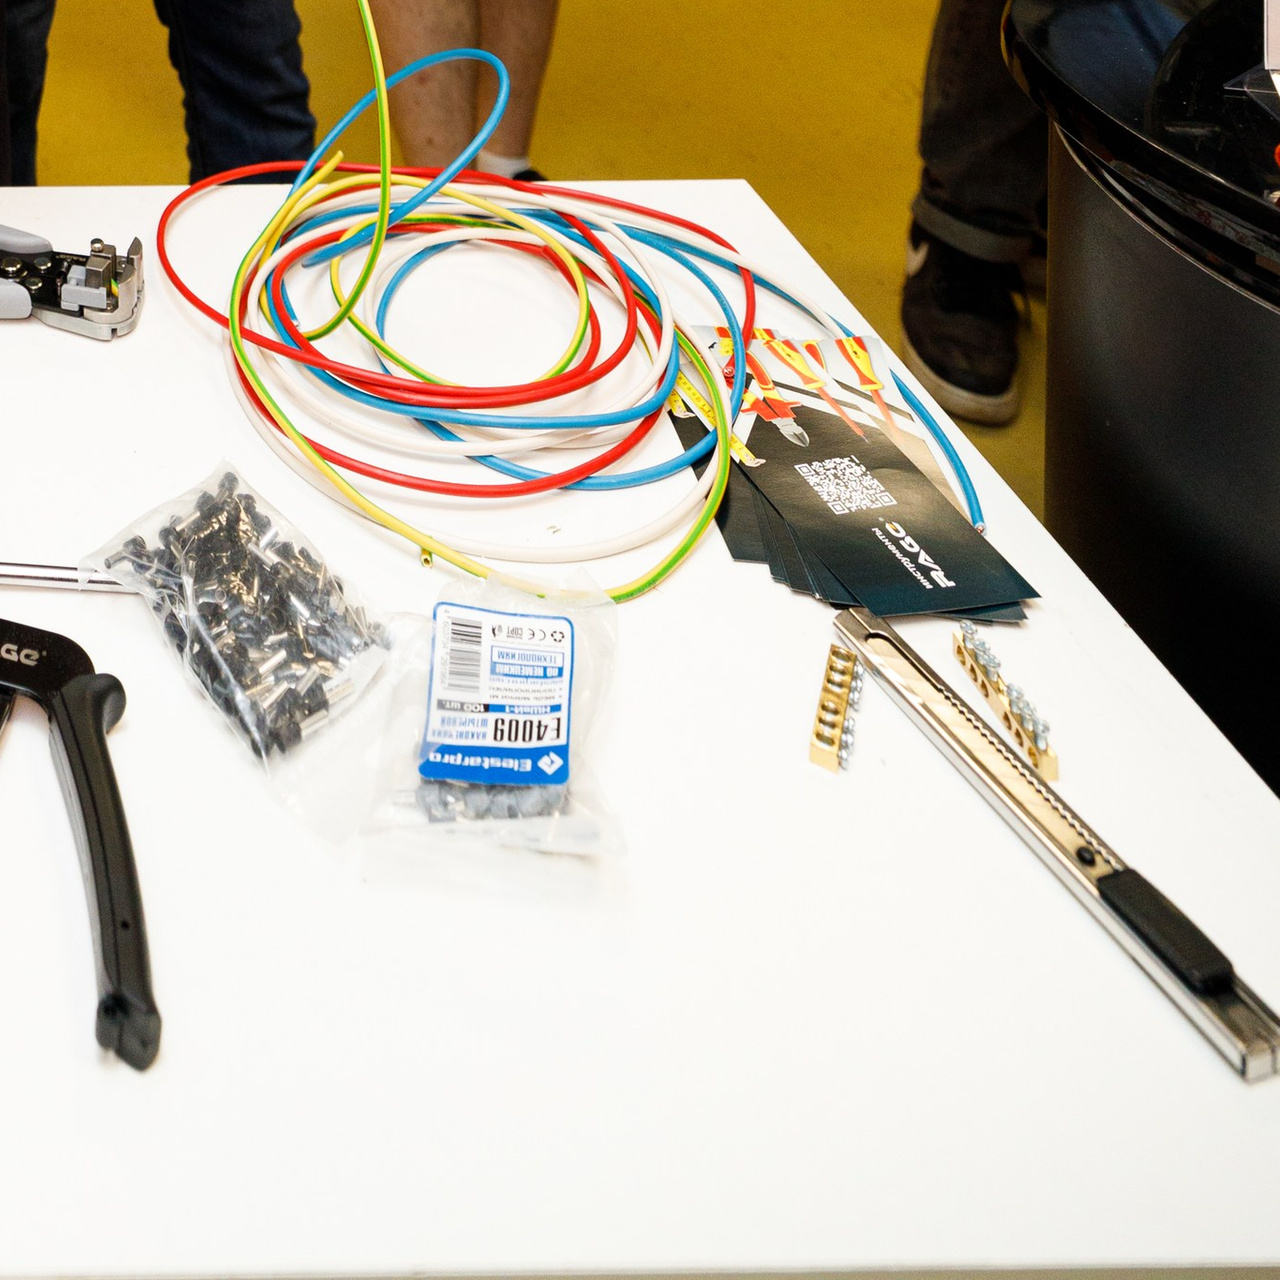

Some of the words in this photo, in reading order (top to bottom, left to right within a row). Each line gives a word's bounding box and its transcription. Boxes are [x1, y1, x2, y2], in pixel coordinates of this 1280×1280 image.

[498, 650, 557, 664] ТЕХНОЛОГИЯМ
[463, 702, 485, 712] 100
[493, 717, 561, 743] E4009
[428, 751, 532, 772] Elestarpro
